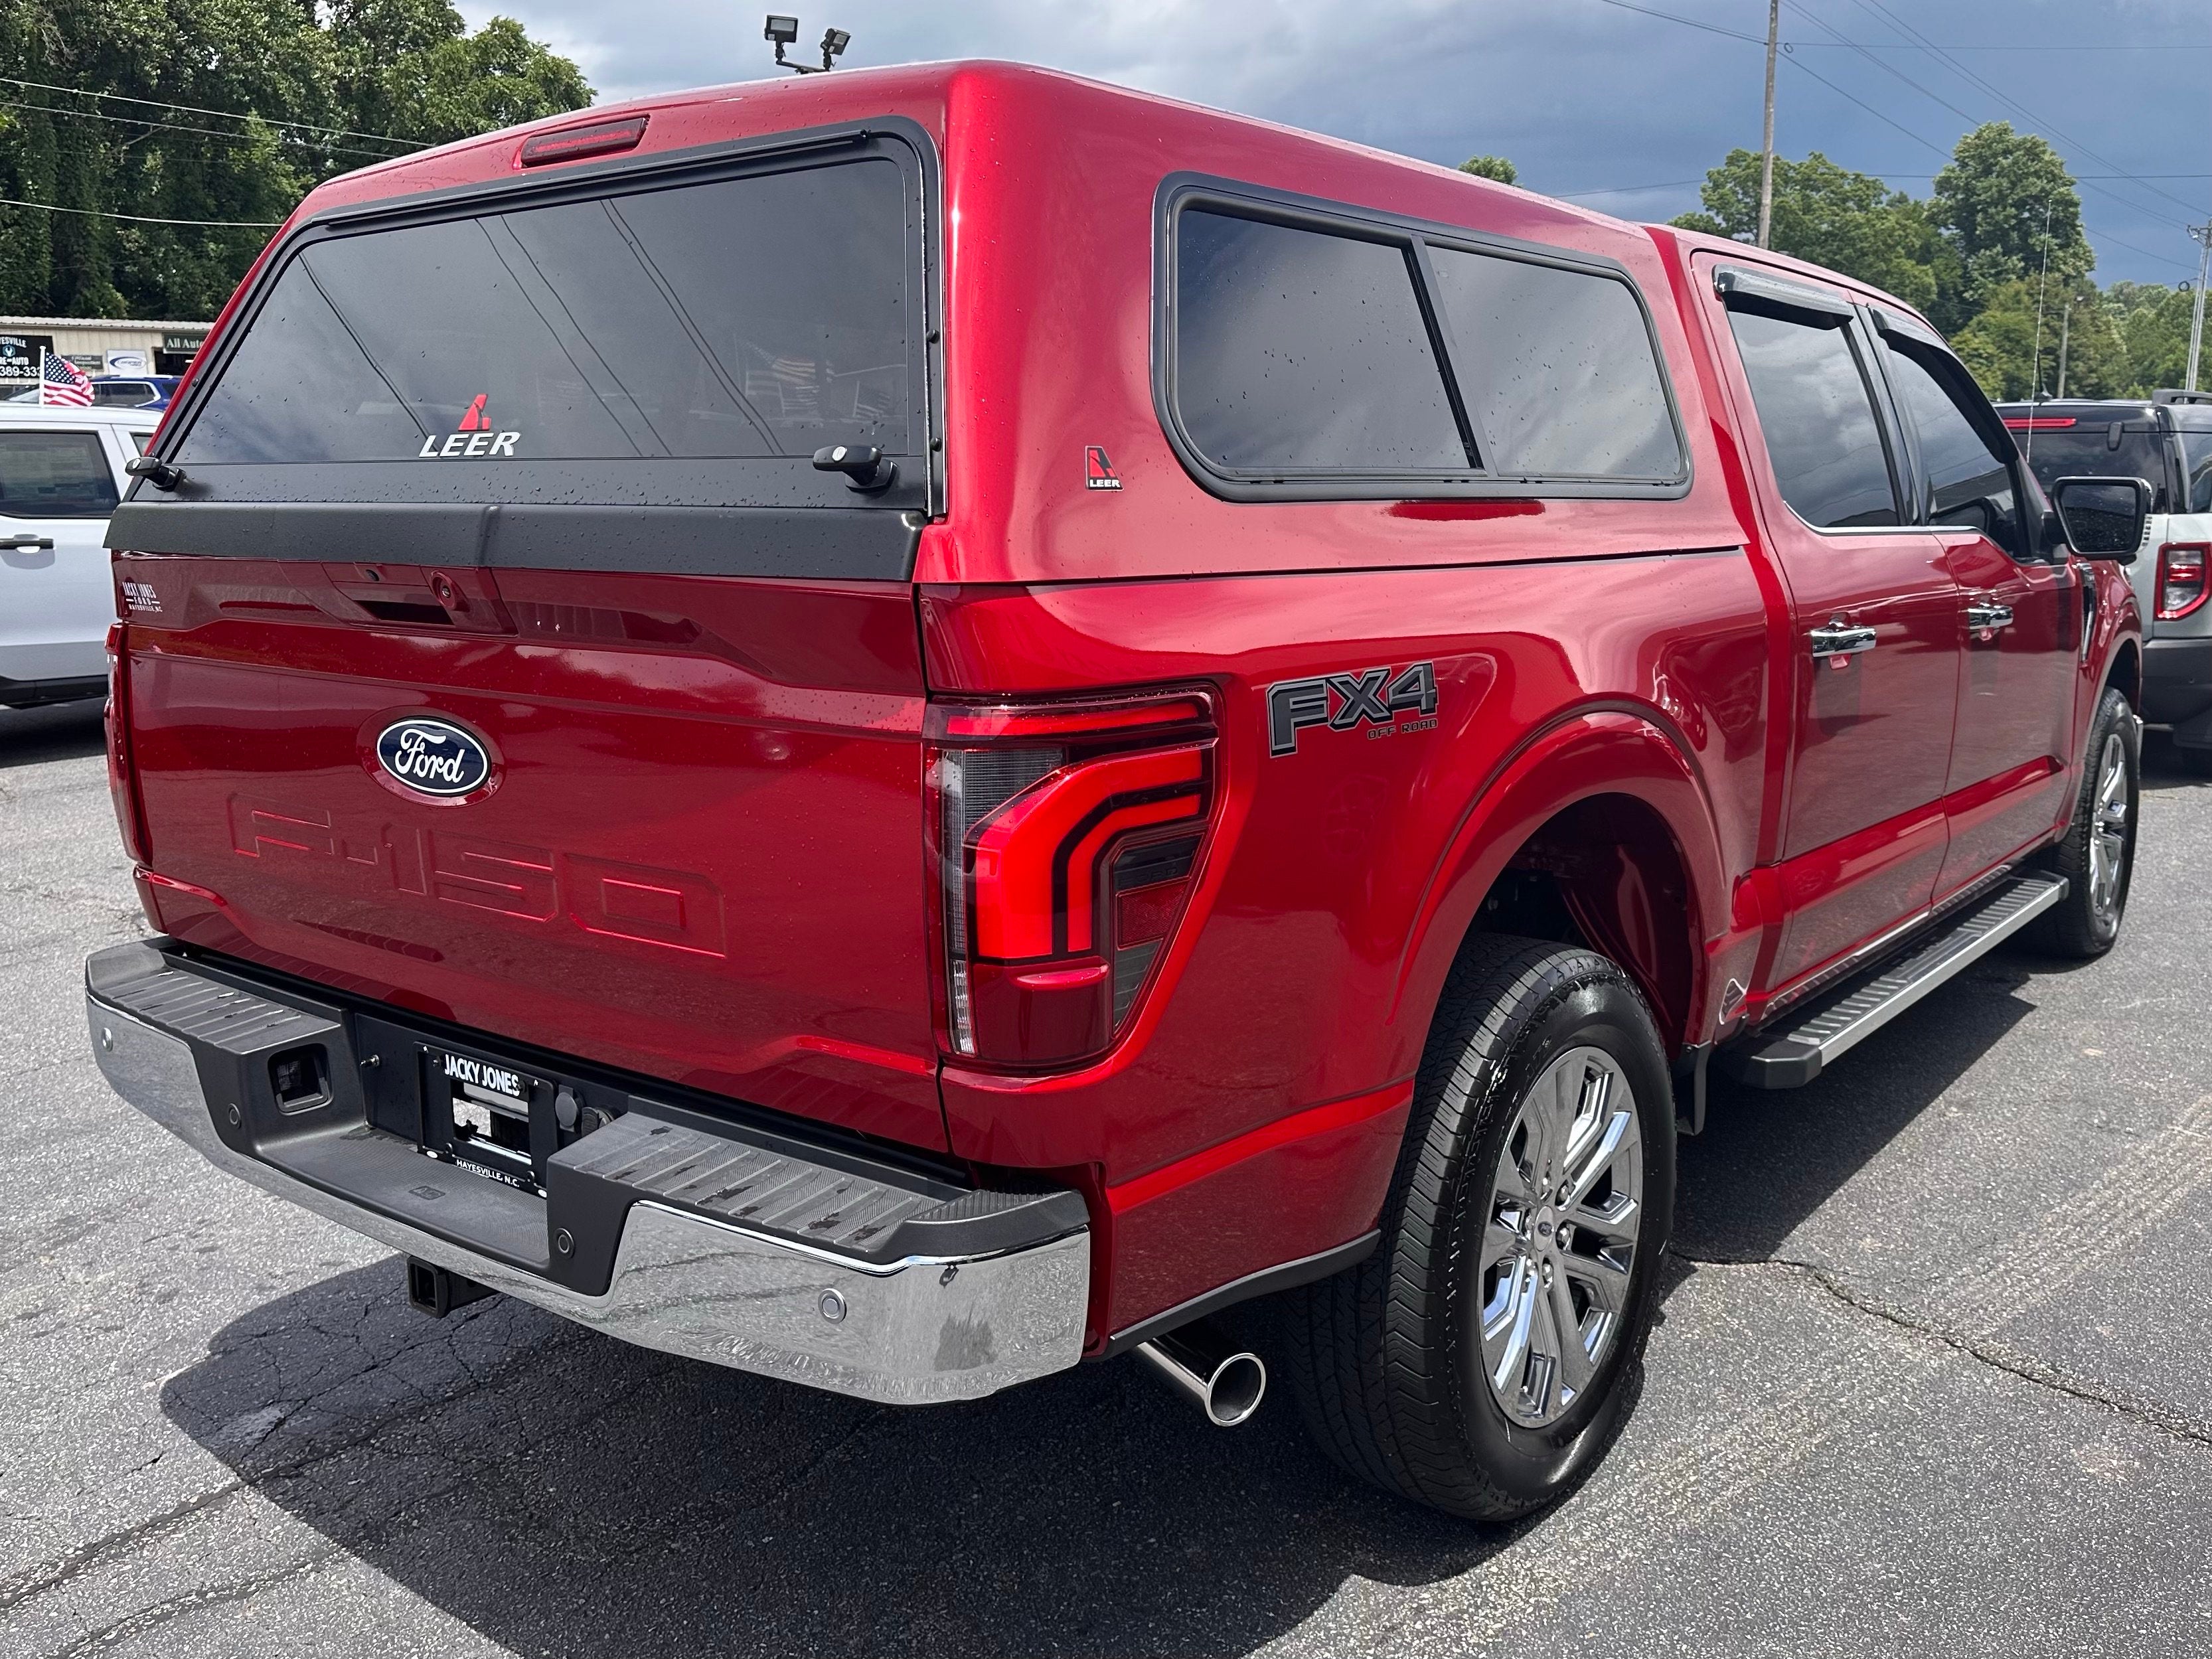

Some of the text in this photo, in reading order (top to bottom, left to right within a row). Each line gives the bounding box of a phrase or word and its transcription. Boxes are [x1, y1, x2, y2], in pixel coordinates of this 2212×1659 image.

[167, 338, 181, 348] All
[419, 432, 522, 457] LEER
[1089, 479, 1121, 487] LEER
[1265, 660, 1439, 758] FX4
[1367, 718, 1438, 740] OFF ROAD
[394, 728, 465, 783] Ford
[227, 793, 726, 958] F-150
[444, 1054, 520, 1097] JACKY JONES
